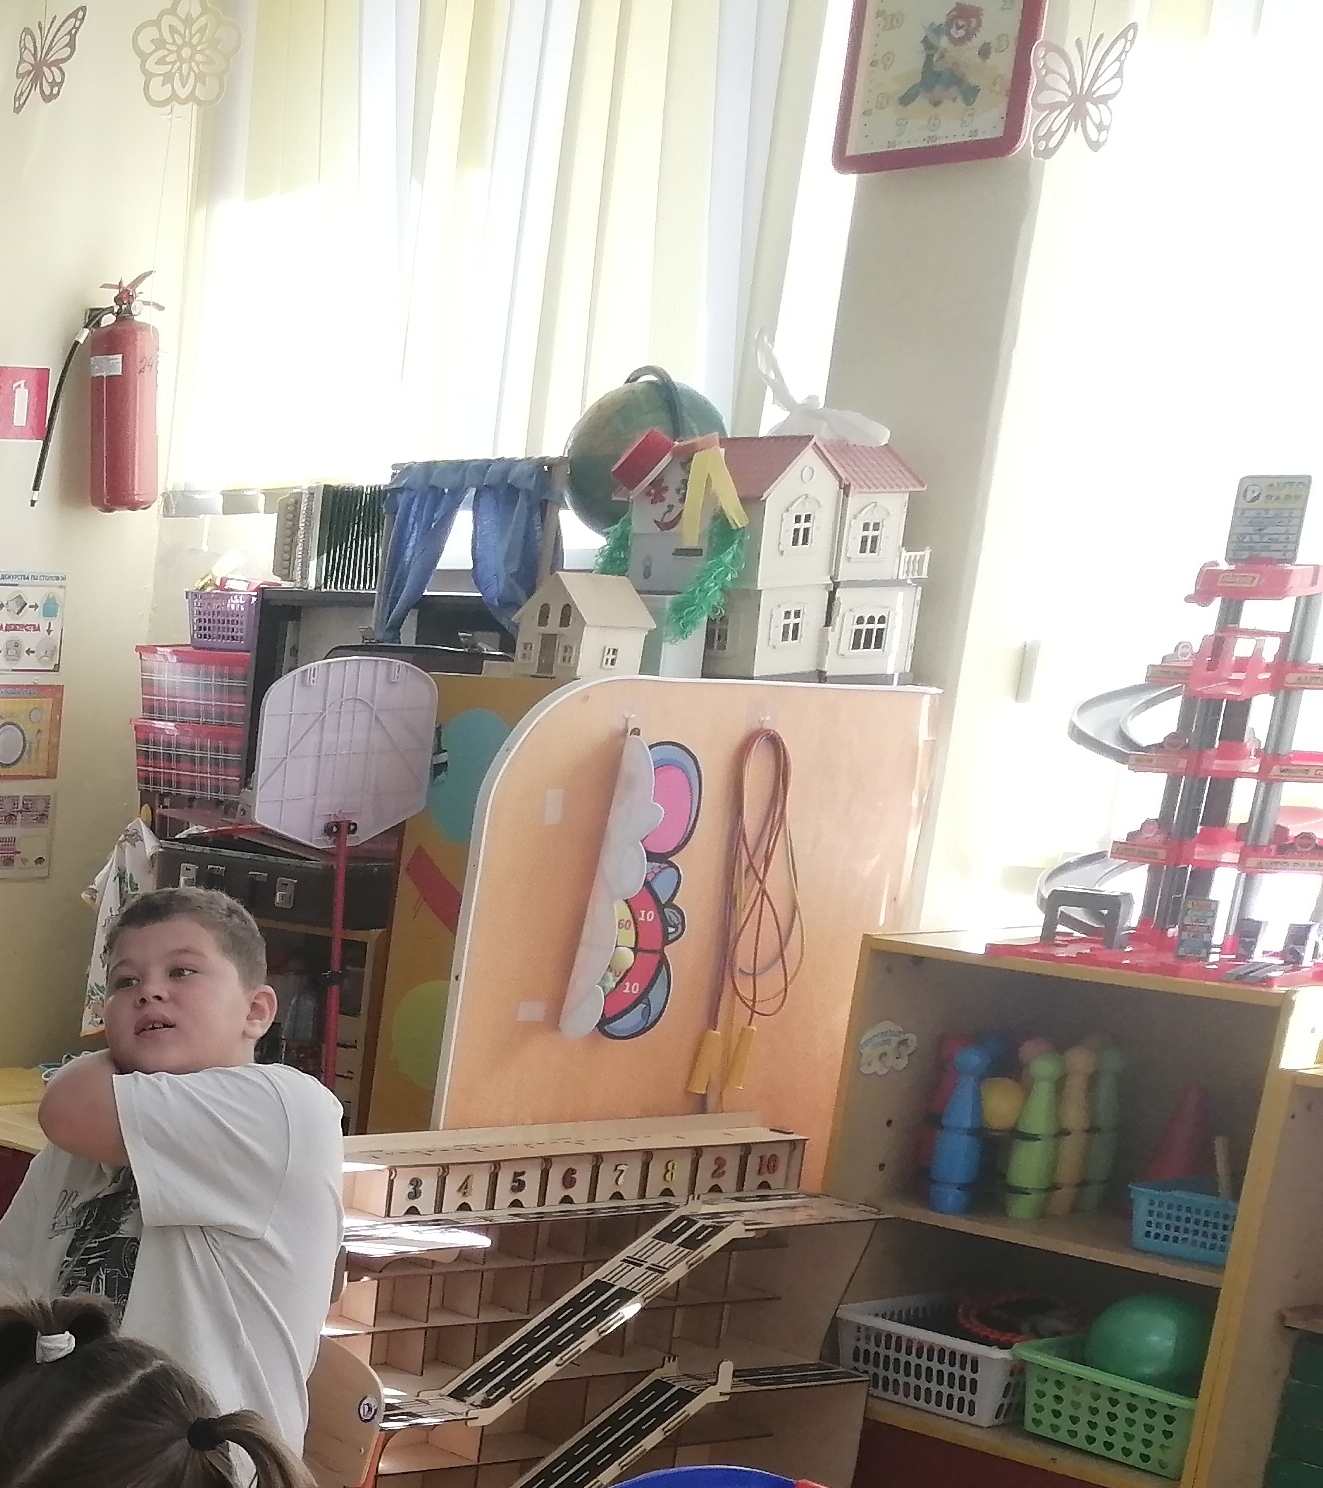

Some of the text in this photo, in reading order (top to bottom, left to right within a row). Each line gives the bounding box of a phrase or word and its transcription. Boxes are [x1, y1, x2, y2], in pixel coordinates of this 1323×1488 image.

[638, 909, 656, 923] 10
[622, 981, 641, 995] 10
[407, 1176, 423, 1201] 3
[455, 1172, 474, 1198] 4
[510, 1169, 527, 1194] 5
[561, 1166, 577, 1190] 6
[613, 1163, 630, 1186] 7
[664, 1159, 677, 1183] 8
[756, 1152, 779, 1176] 10
